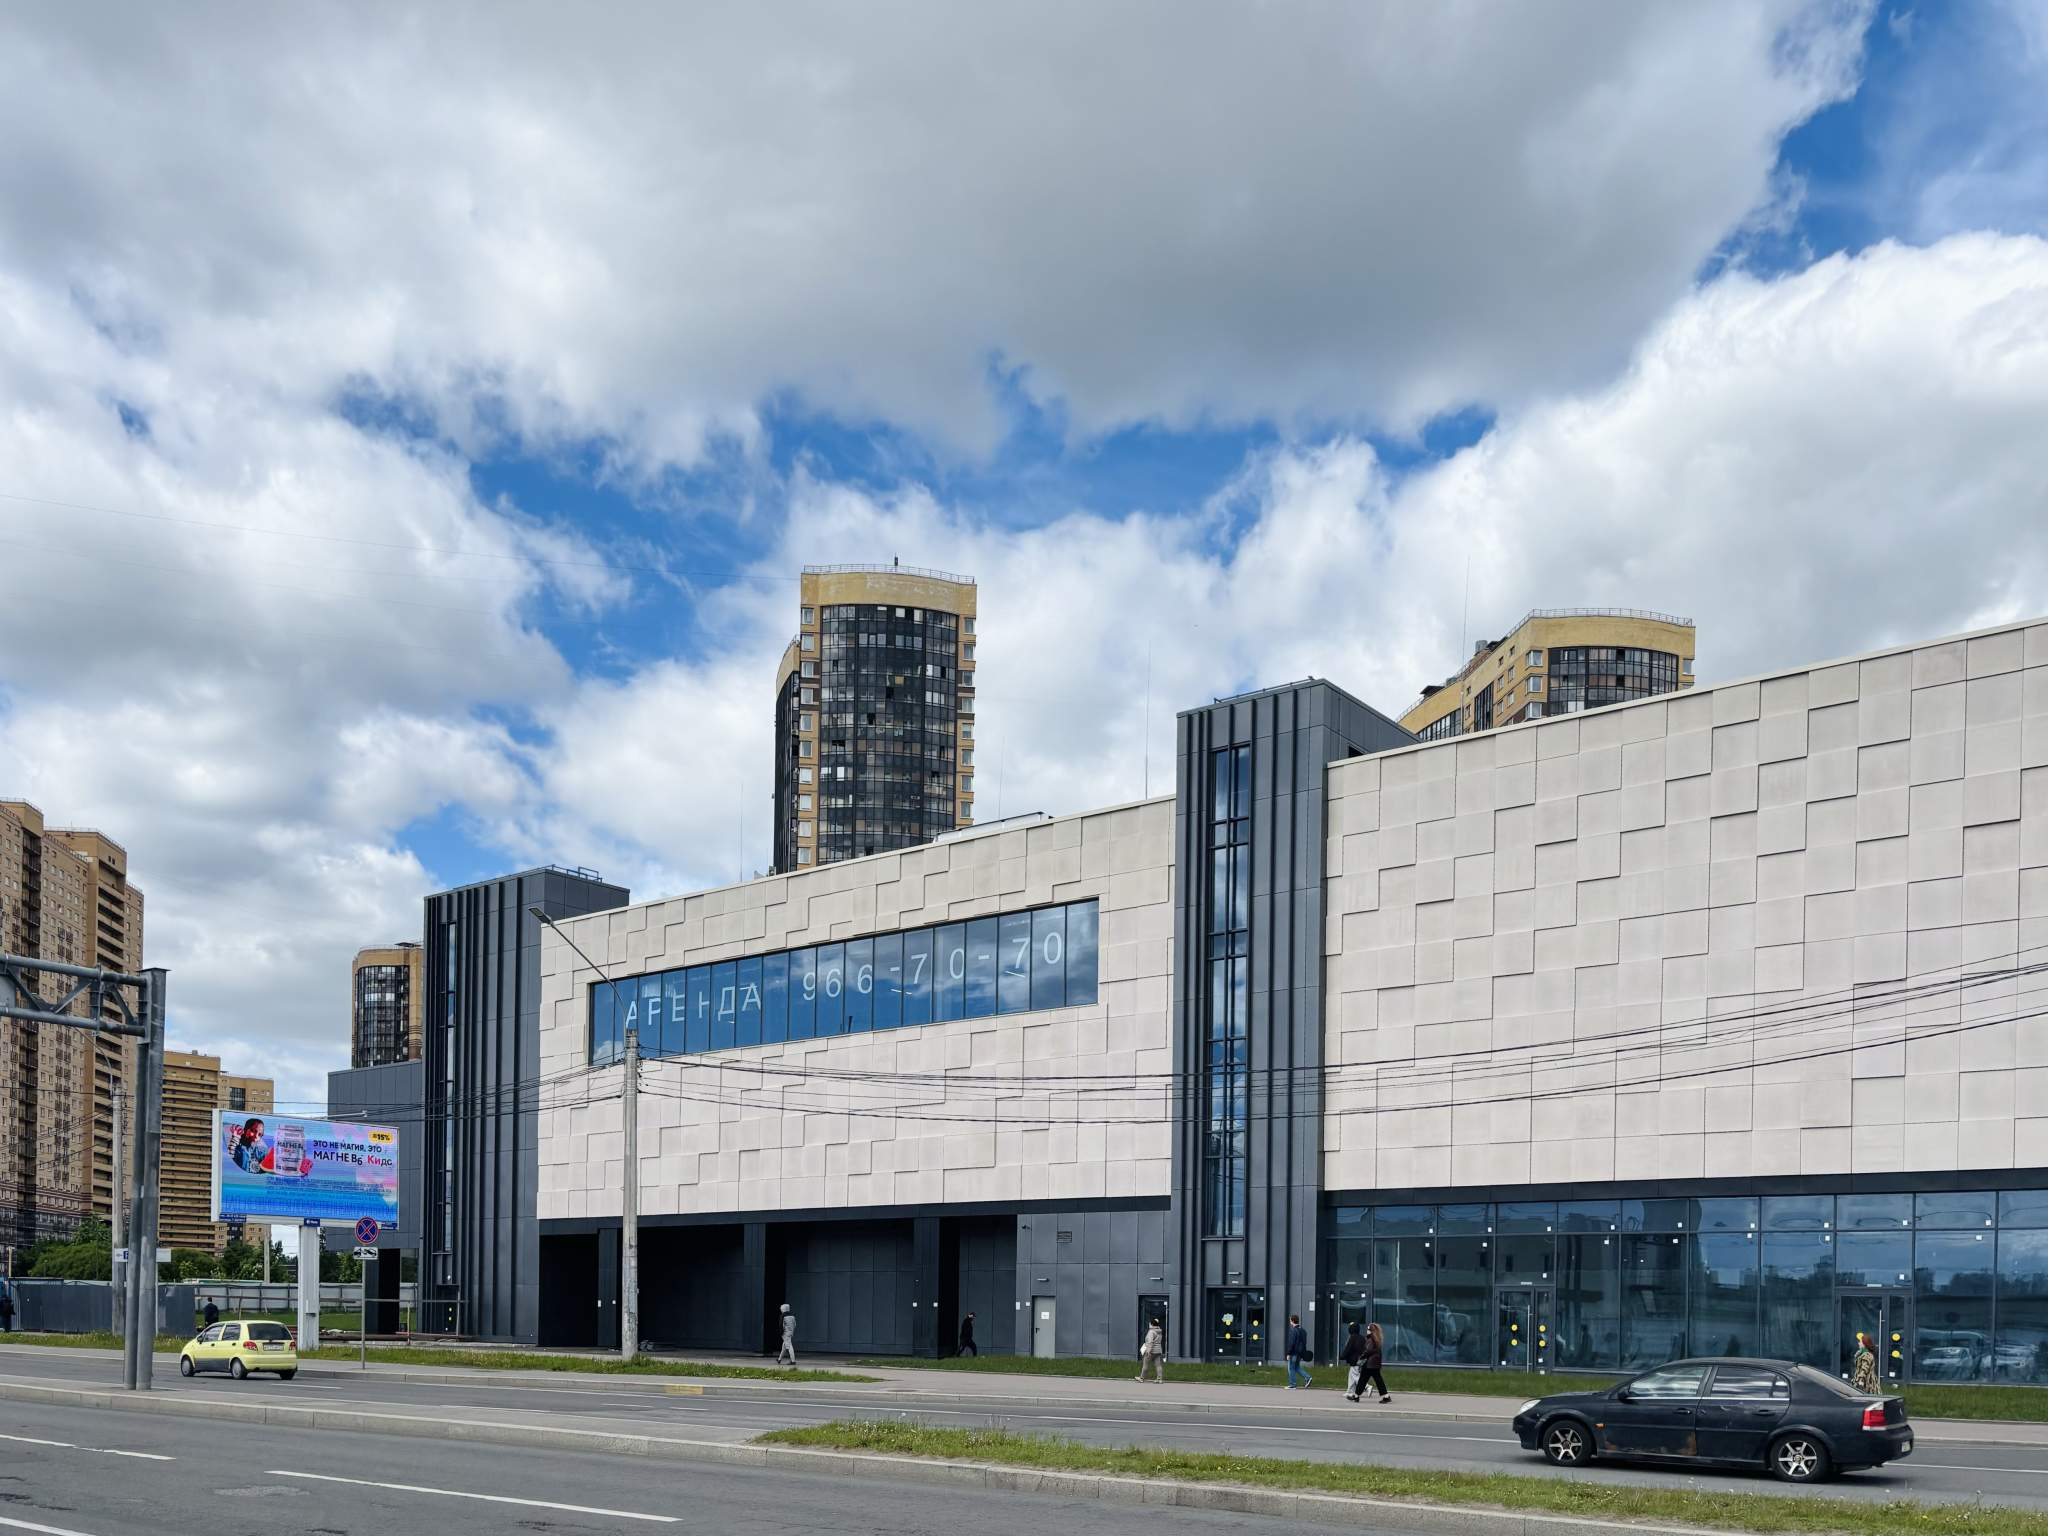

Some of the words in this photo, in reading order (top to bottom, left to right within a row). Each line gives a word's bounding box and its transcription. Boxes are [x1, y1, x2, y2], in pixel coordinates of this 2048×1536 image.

[625, 982, 762, 1028] АРЕНДА
[313, 1140, 328, 1148] ЭТО
[329, 1141, 339, 1149] НЕ
[367, 1145, 382, 1153] ЭТО
[313, 1150, 350, 1163] МАГНЕ
[367, 1154, 393, 1167] Кидс
